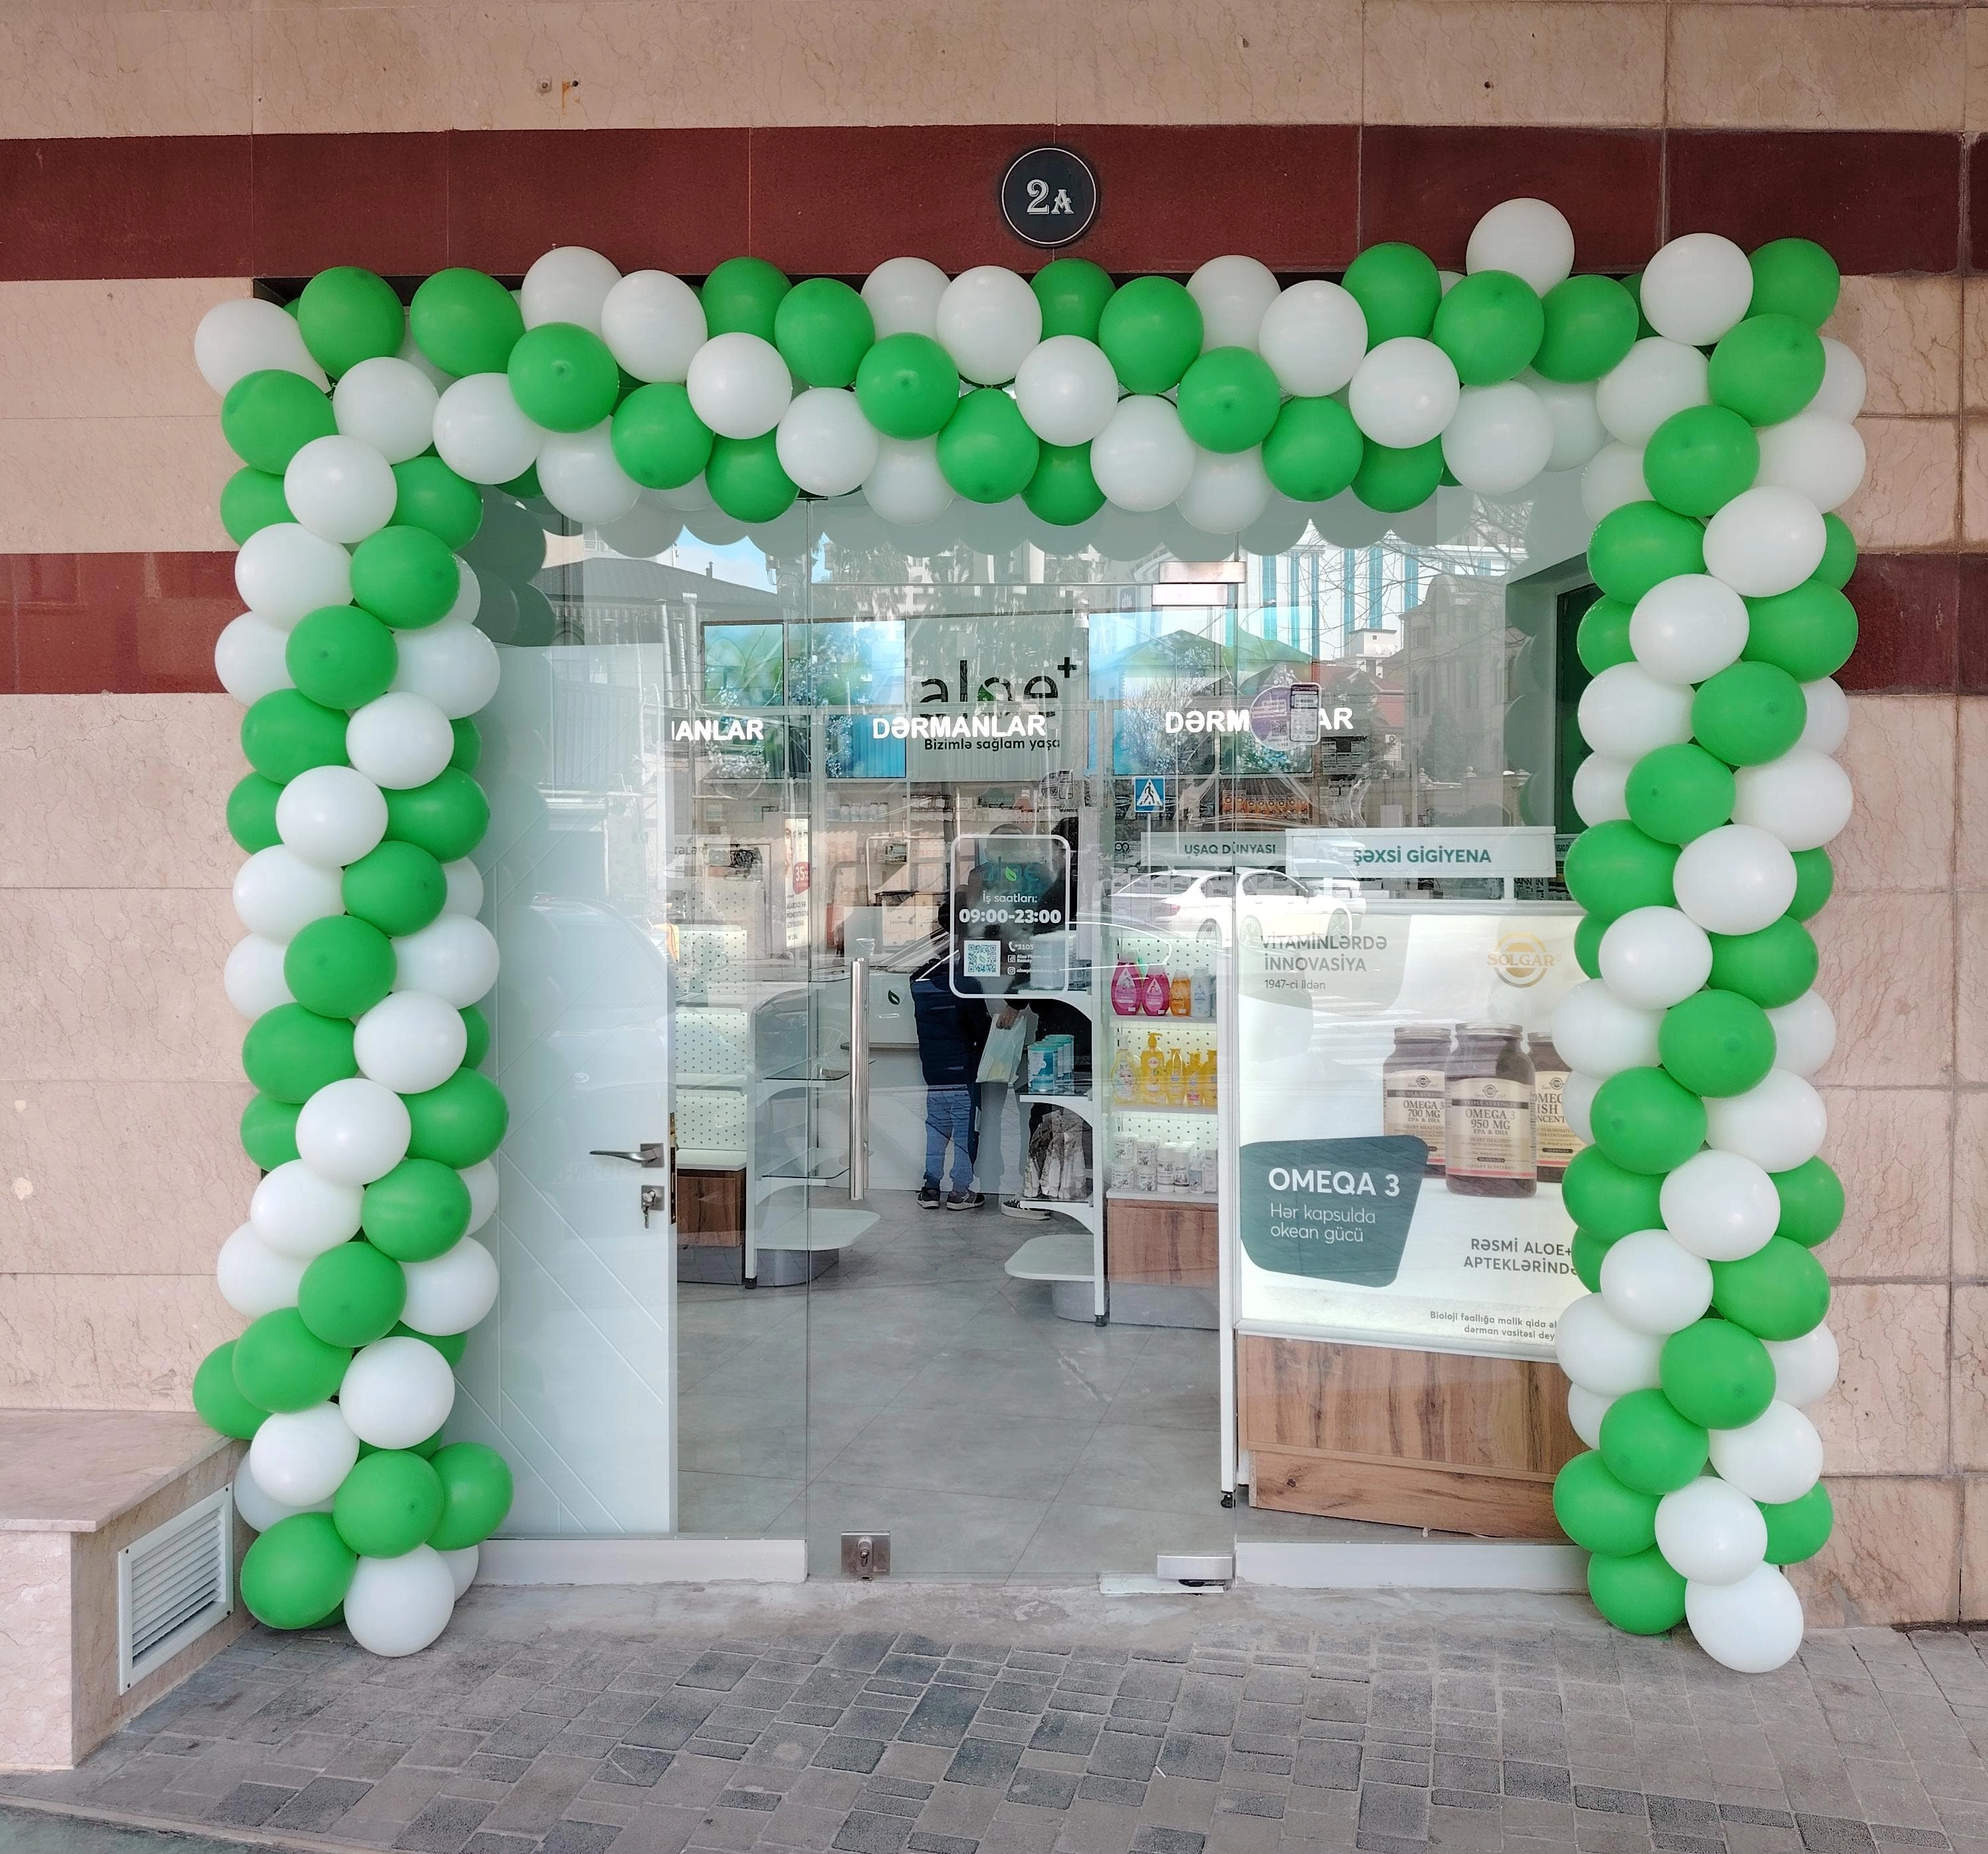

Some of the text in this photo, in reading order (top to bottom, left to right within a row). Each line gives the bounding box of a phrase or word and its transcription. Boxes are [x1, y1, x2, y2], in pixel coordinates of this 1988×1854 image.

[1027, 179, 1074, 215] 2A
[872, 714, 1046, 740] DƏRMANLAR
[1165, 706, 1353, 734] DƏRMAR
[671, 720, 764, 741] ANLAR
[924, 738, 972, 750] Bizimlə
[976, 738, 1025, 752] sağlam
[1185, 841, 1276, 857] UŞAQ DÜNYASI
[1353, 845, 1492, 867] ŞƏXSİ GİGİYENA
[982, 890, 991, 904] İş
[959, 908, 1062, 924] 09:00-23:00
[1260, 932, 1387, 950] VİTAMİNLƏRDƏ
[1264, 953, 1367, 972] İNNOVASİYA
[1487, 953, 1555, 967] SOLGAR
[1264, 979, 1326, 989] 1947-ci ildən
[1403, 1100, 1438, 1109] OMEGA
[1465, 1108, 1507, 1119] OMEGA
[1471, 1119, 1510, 1130] 950 MG
[1268, 1167, 1400, 1197] OMEQA 3
[1270, 1202, 1376, 1225] Hər kapsulda
[1270, 1222, 1363, 1244] okean gücü
[1470, 1237, 1519, 1253] RƏSMİ
[1430, 1310, 1458, 1322] Bioloji
[1460, 1312, 1495, 1325] fəallığa
[1498, 1316, 1523, 1326] malik
[1526, 1318, 1546, 1328] qida
[1464, 1324, 1499, 1336] dərman
[1502, 1328, 1536, 1338] vasitəsi
